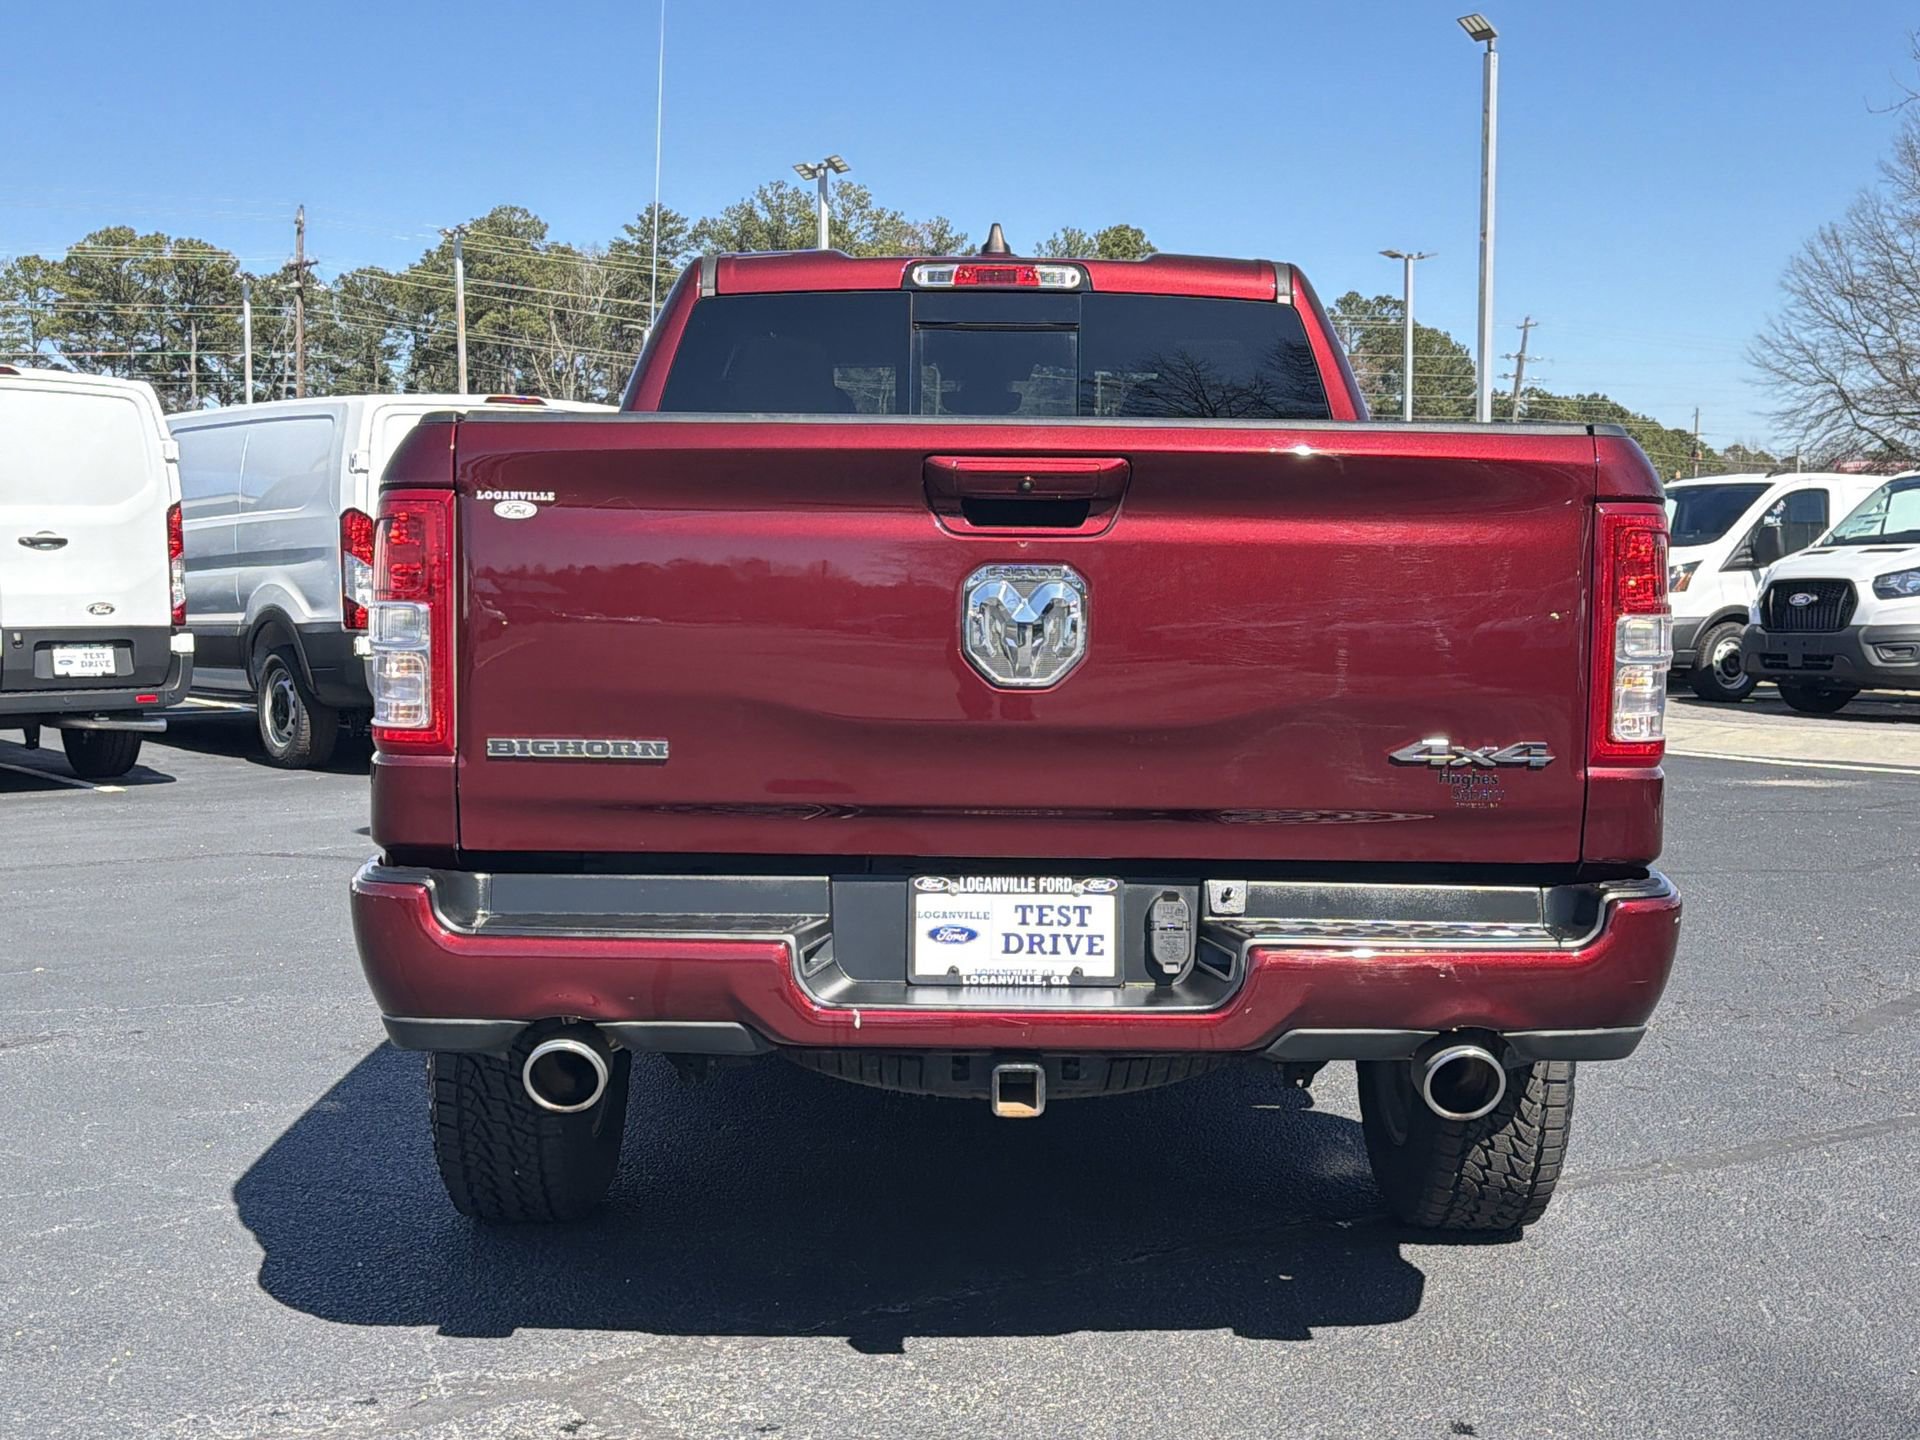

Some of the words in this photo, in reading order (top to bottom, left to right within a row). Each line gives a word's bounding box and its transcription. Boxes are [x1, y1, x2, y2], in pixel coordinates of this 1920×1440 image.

[476, 490, 555, 501] LOGANVILLE
[987, 567, 1062, 580] RAM
[83, 652, 106, 660] TEST
[487, 738, 669, 759] BIGHORN
[1439, 769, 1498, 788] Hughes
[960, 876, 1036, 893] LOGANVILLE
[1039, 877, 1073, 893] FORD
[917, 911, 990, 920] LOGANVILLE
[1014, 904, 1092, 927] TEST
[935, 927, 970, 942] Ford
[1001, 933, 1104, 956] DRIVE
[962, 975, 1046, 986] LOGANVILLE,
[1050, 976, 1070, 985] GA
